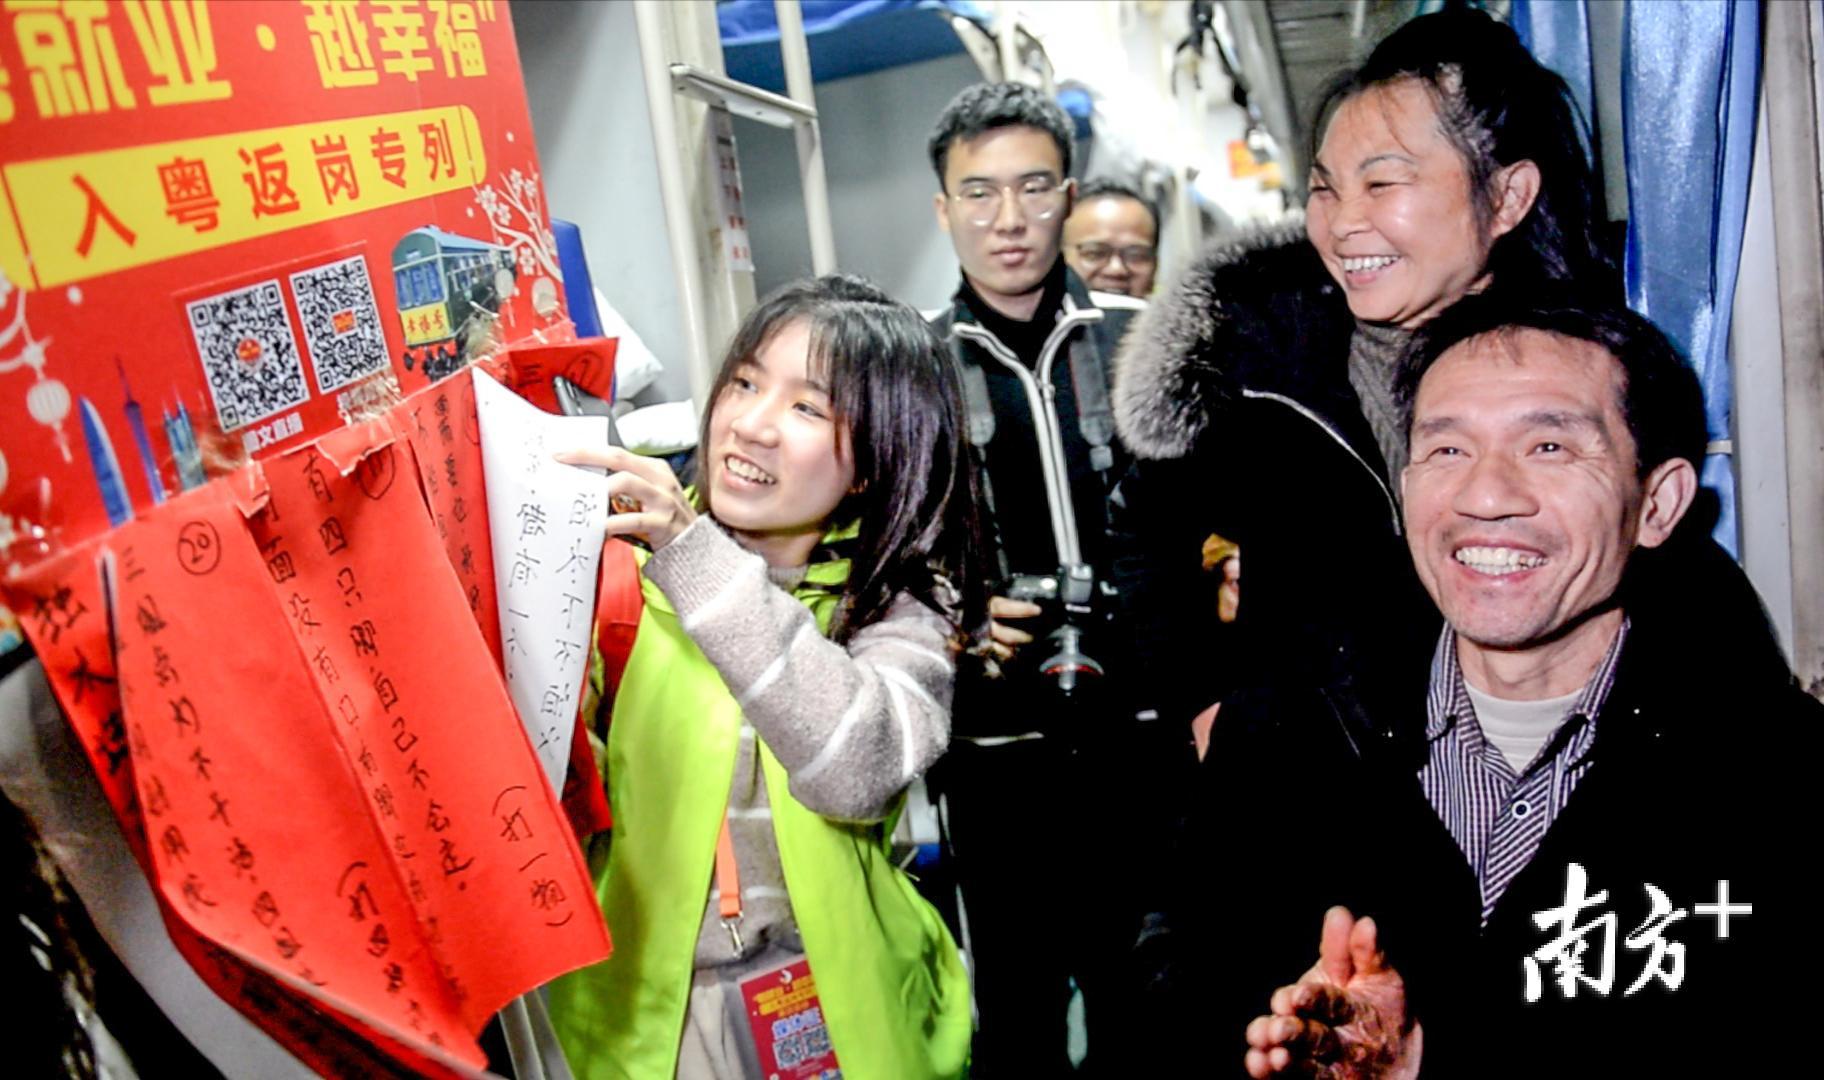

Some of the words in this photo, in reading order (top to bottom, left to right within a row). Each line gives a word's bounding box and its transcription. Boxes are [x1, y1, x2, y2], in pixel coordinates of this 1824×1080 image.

[73, 118, 457, 259] 入粤返岗专列
[179, 527, 217, 570] 20
